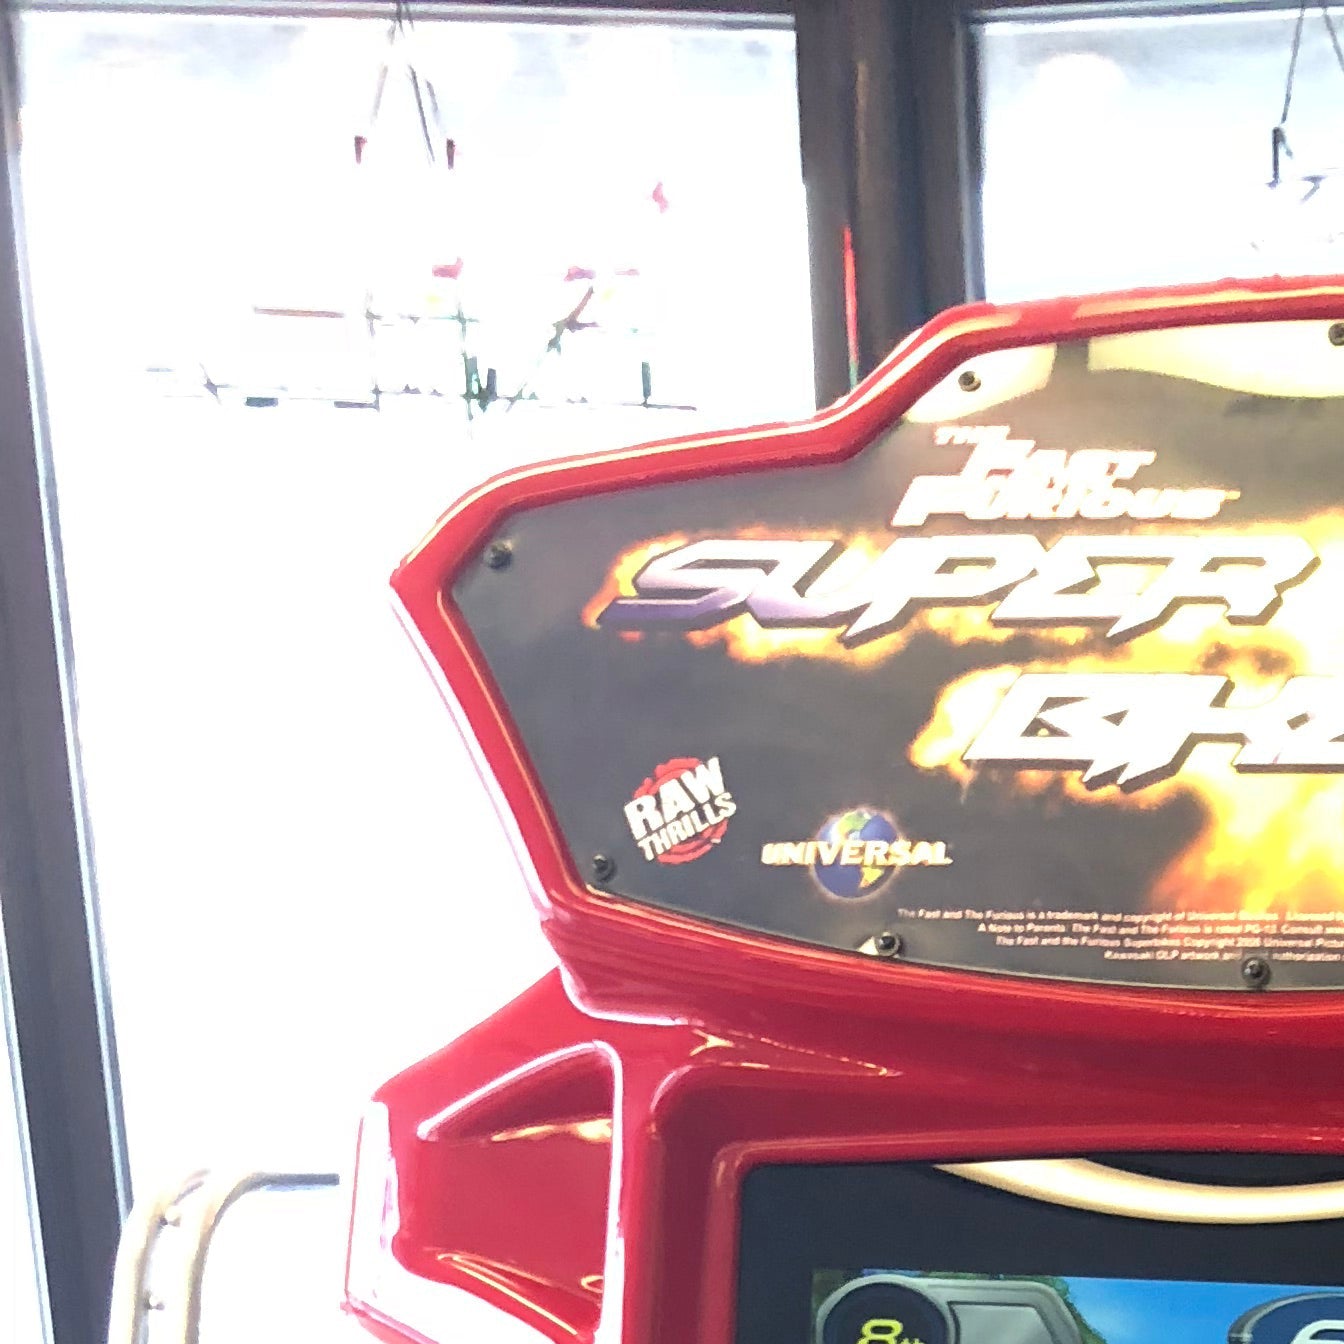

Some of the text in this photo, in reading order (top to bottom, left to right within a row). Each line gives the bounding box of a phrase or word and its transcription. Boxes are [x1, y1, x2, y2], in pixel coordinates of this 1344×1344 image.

[597, 534, 1321, 645] SUPER
[624, 757, 726, 840] RAW
[638, 792, 737, 862] THRILLS
[761, 840, 953, 867] UNIVERSAL
[918, 908, 941, 919] Fast
[942, 909, 963, 920] and
